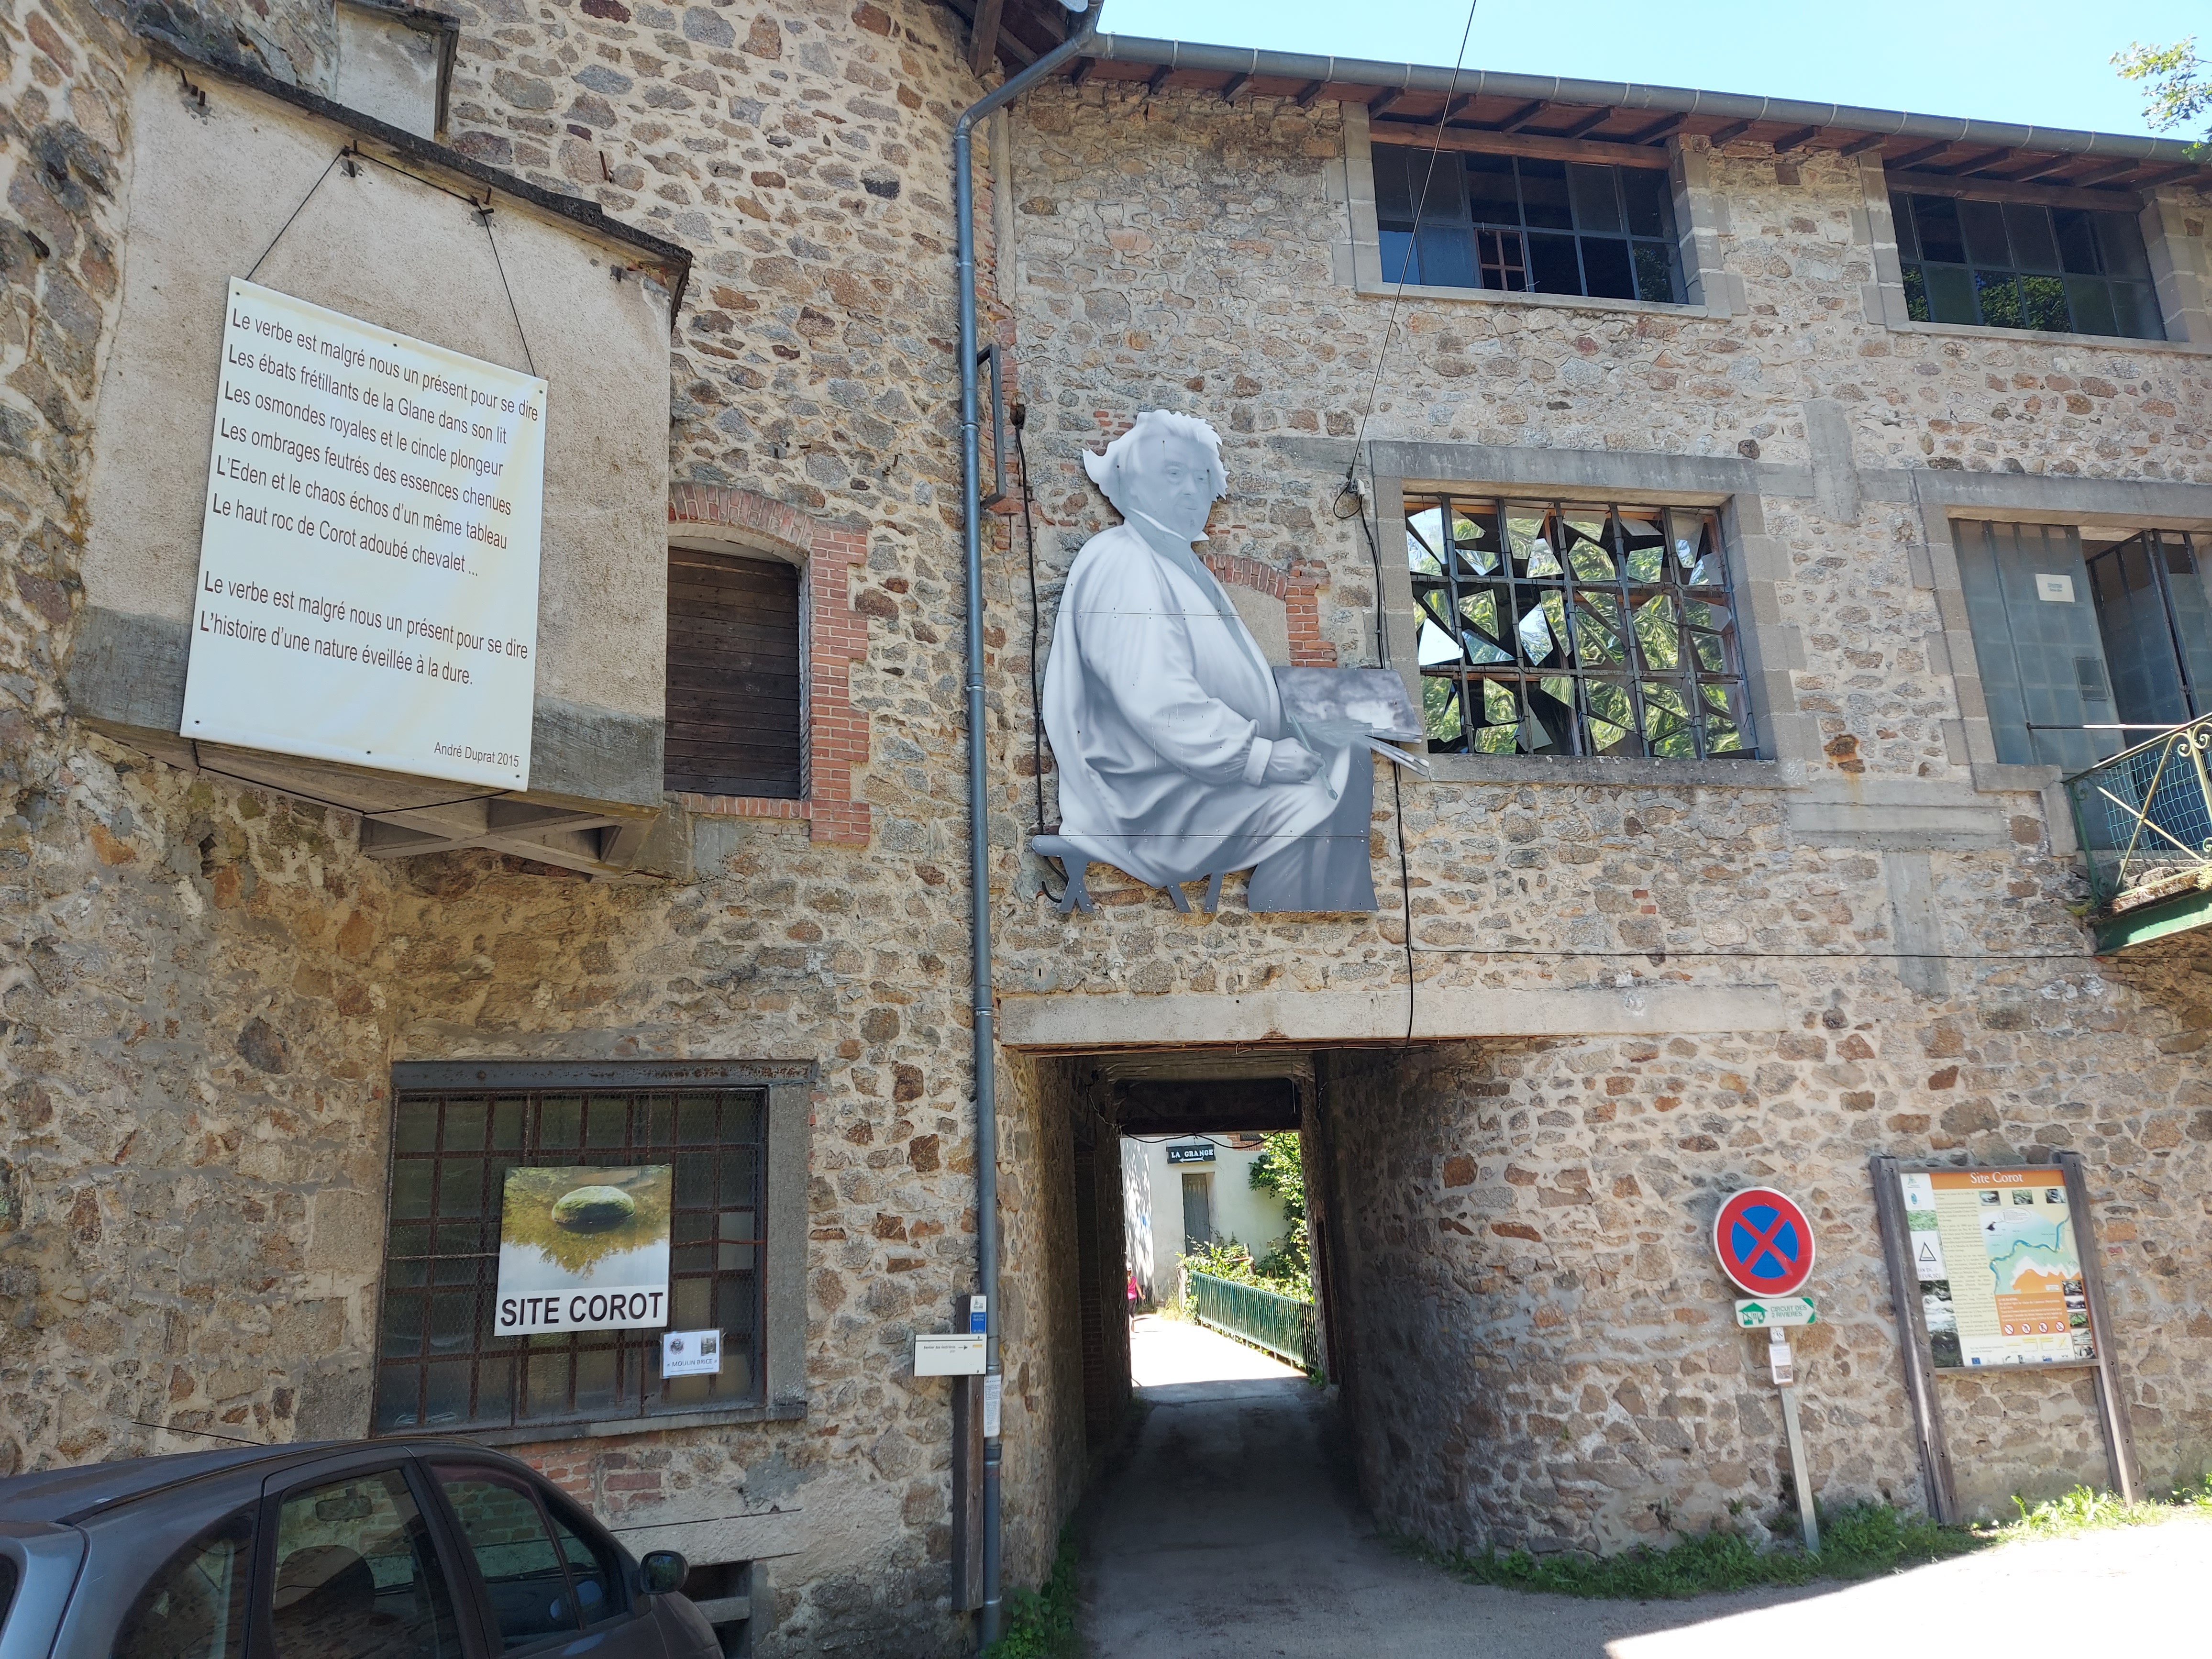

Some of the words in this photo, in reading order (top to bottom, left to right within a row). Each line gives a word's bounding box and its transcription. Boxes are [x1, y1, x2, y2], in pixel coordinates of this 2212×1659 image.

[229, 343, 254, 368] Les
[259, 353, 296, 381] ébats
[300, 365, 359, 401] frétillants
[363, 387, 379, 407] de
[383, 391, 394, 412] la
[398, 398, 435, 424] Glane
[439, 410, 468, 433] dans
[471, 423, 492, 442] son
[497, 426, 507, 444] lit
[232, 308, 250, 330] Le
[255, 319, 292, 343] verbe
[297, 333, 317, 353] est
[321, 341, 365, 368] malgré
[369, 356, 399, 378] nous
[404, 367, 419, 385] un
[422, 374, 468, 400] présent
[471, 389, 498, 409] pour
[500, 398, 515, 413] se
[519, 399, 538, 421] dire
[221, 418, 247, 442] Les
[251, 431, 320, 463] ombrages
[324, 446, 369, 476] feutrés
[373, 462, 396, 484] des
[400, 473, 458, 501] essences
[463, 487, 511, 516] chenues
[225, 380, 251, 405] Les
[255, 394, 326, 427] osmondes
[330, 416, 376, 442] royales
[380, 430, 393, 448] et
[396, 431, 407, 451] le
[411, 437, 446, 462] cincle
[450, 449, 504, 476] plongeur
[212, 493, 231, 516] Le
[235, 498, 268, 525] haut
[271, 513, 294, 531] roc
[298, 515, 315, 536] de
[320, 520, 356, 547] Corot
[360, 533, 408, 560] adoubé
[412, 545, 465, 573] chevalet
[217, 454, 266, 487] L'Eden
[272, 472, 286, 491] et
[289, 474, 301, 495] le
[305, 480, 345, 507] chaos
[350, 491, 388, 518] échos
[392, 502, 419, 526] d'un
[423, 513, 462, 536] même
[466, 520, 507, 550] tableau
[200, 610, 266, 643] L'histoire
[271, 626, 310, 652] d'une
[314, 639, 358, 661] nature
[362, 644, 412, 671] éveillée
[416, 654, 424, 675] à
[428, 656, 438, 678] la
[442, 661, 473, 685] dure.
[204, 570, 223, 594] Le
[228, 581, 268, 604] verbe
[273, 591, 295, 610] est
[299, 596, 345, 622] malgré
[350, 608, 382, 628] nous
[387, 616, 402, 632] un
[407, 618, 454, 644] présent
[456, 631, 485, 651] pour
[487, 639, 502, 653] se
[506, 638, 528, 659] dire
[434, 741, 462, 758] André
[465, 746, 495, 764] Duprat
[497, 752, 520, 767] 2015
[1184, 1149, 1214, 1157] GRANGE
[1970, 1172, 1990, 1183] Site
[1992, 1171, 2024, 1183] Corot
[500, 1297, 560, 1327] SITE
[569, 1292, 664, 1323] COROT
